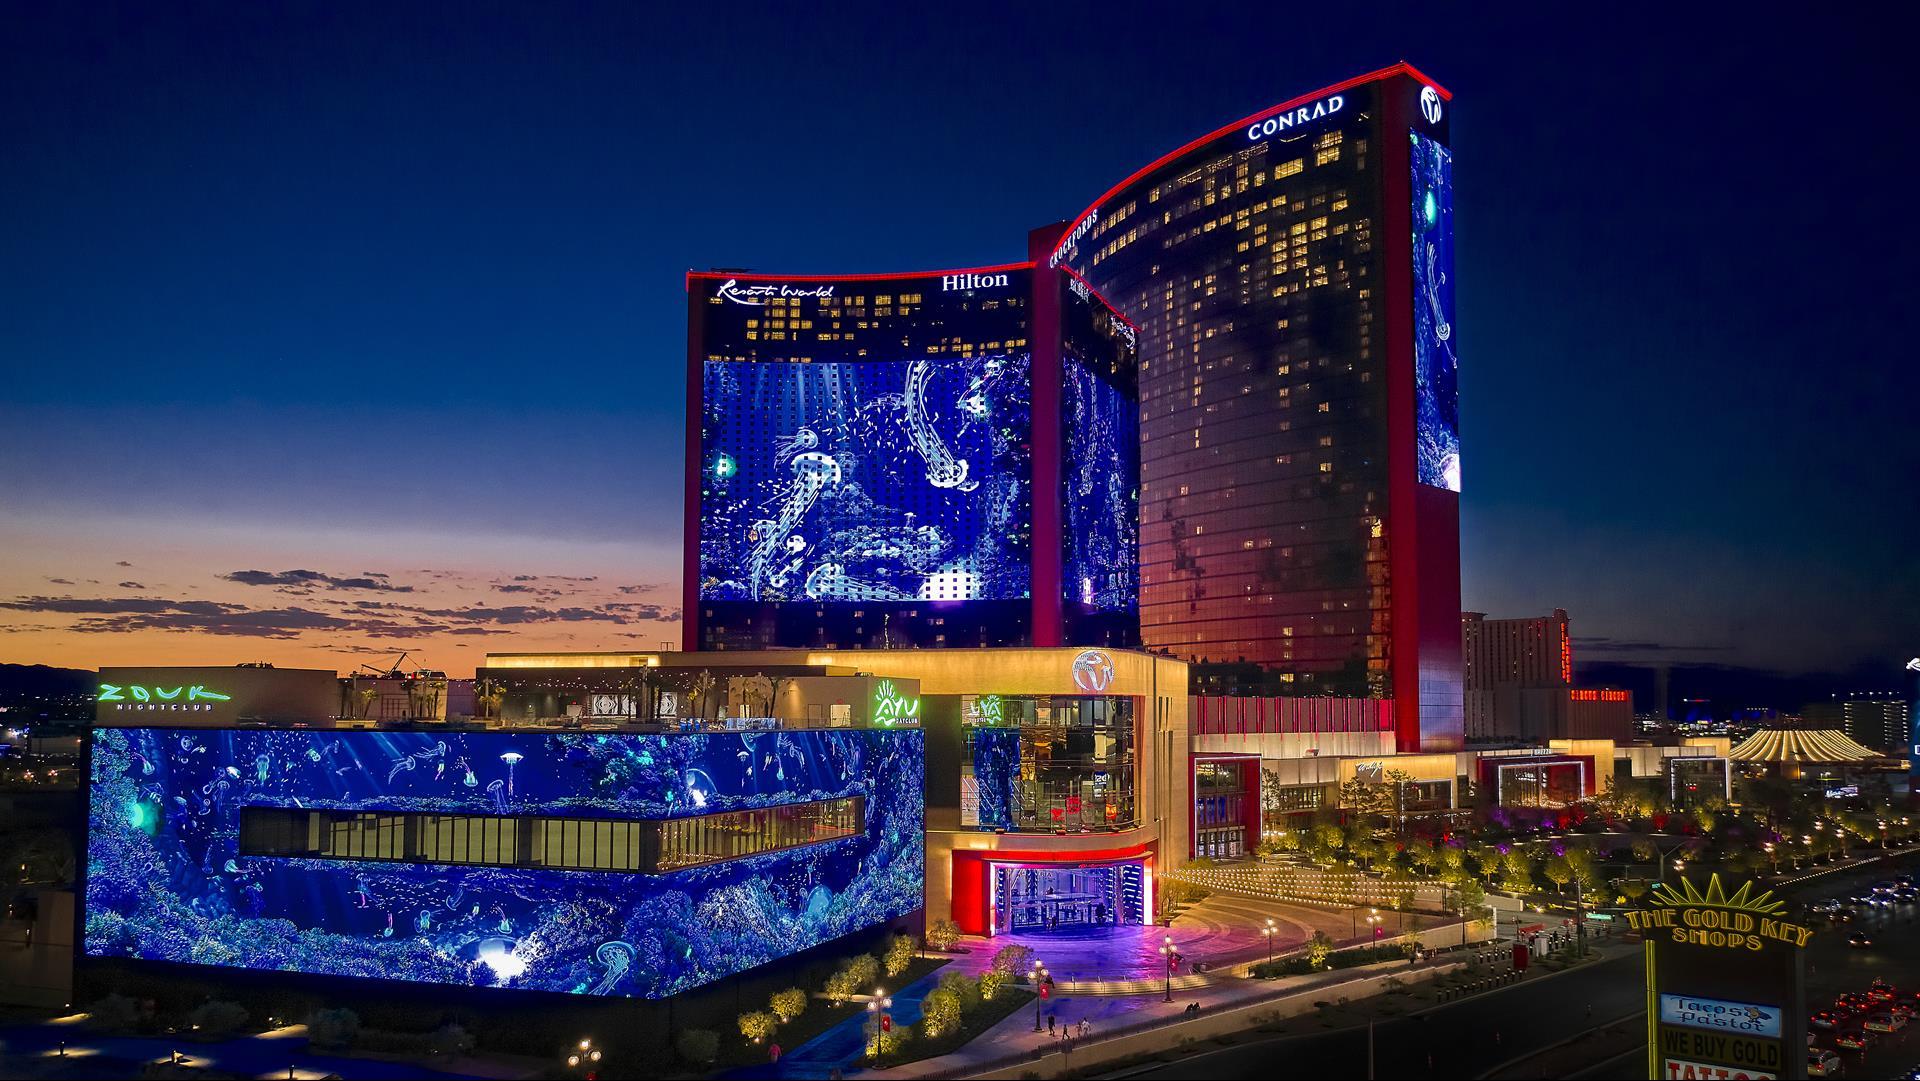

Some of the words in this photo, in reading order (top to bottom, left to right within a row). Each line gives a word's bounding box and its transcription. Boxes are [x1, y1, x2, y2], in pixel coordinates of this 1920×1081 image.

[1248, 96, 1344, 140] CONRAD
[1049, 208, 1098, 269] CROCKFORDS
[716, 279, 774, 305] Resorts
[781, 285, 834, 298] World
[942, 273, 1009, 292] Hilton
[98, 684, 231, 703] ZOUK
[875, 697, 918, 717] AYU
[1623, 908, 1678, 929] THE
[1683, 908, 1753, 932] GOLD
[1760, 917, 1815, 948] KEY
[1671, 927, 1763, 950] SHOPS
[1669, 997, 1742, 1016] Tacos
[1676, 1011, 1765, 1031] Pastor
[1664, 1030, 1688, 1054] WE
[1694, 1034, 1726, 1060] BUY
[1733, 1040, 1778, 1067] GOLD
[1668, 1061, 1772, 1080] TATT
